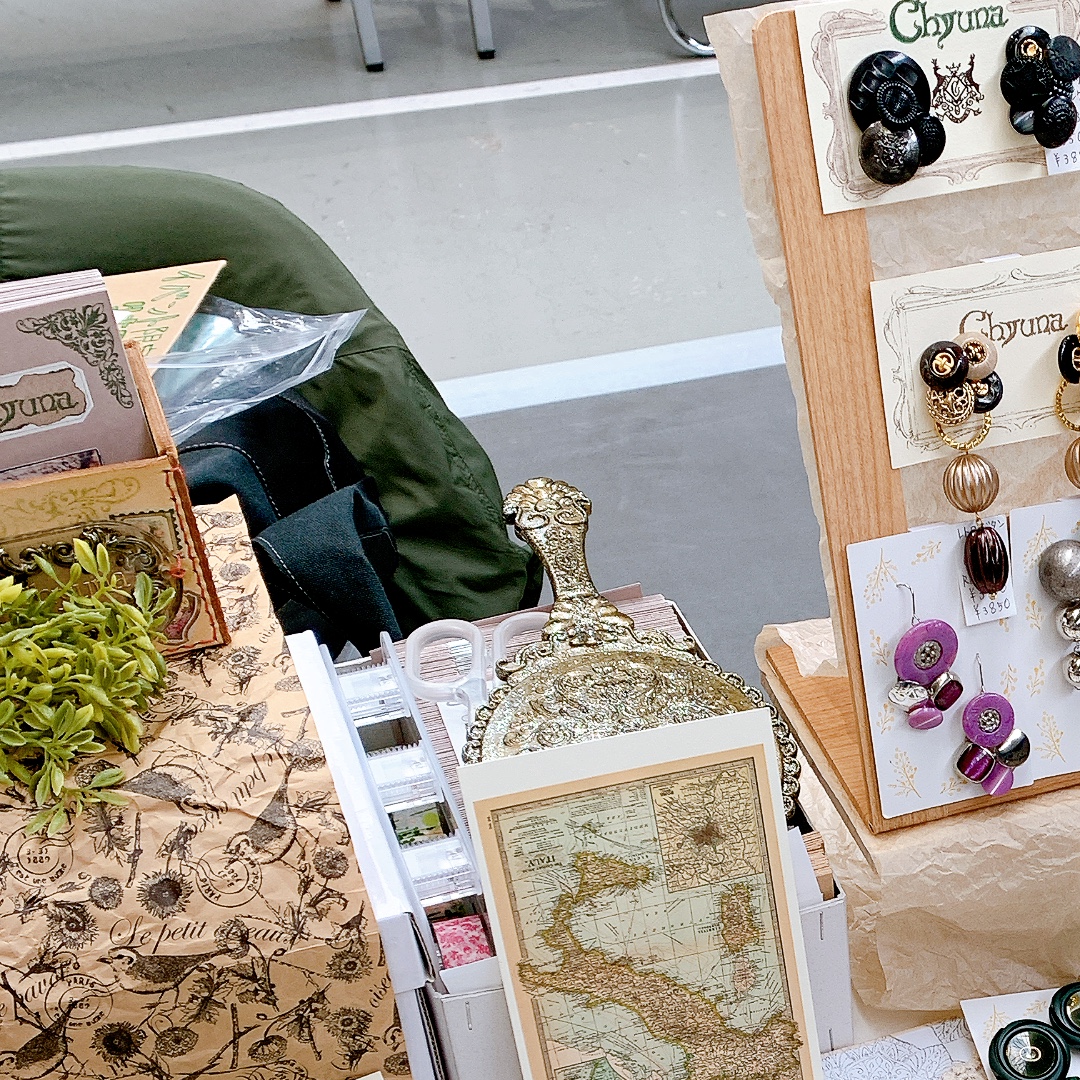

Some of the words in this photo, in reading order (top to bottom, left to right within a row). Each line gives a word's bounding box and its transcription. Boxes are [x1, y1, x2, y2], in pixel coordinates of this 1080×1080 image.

[890, 0, 1009, 49] Chyuna
[0, 391, 79, 432] yuna
[152, 921, 207, 955] petit
